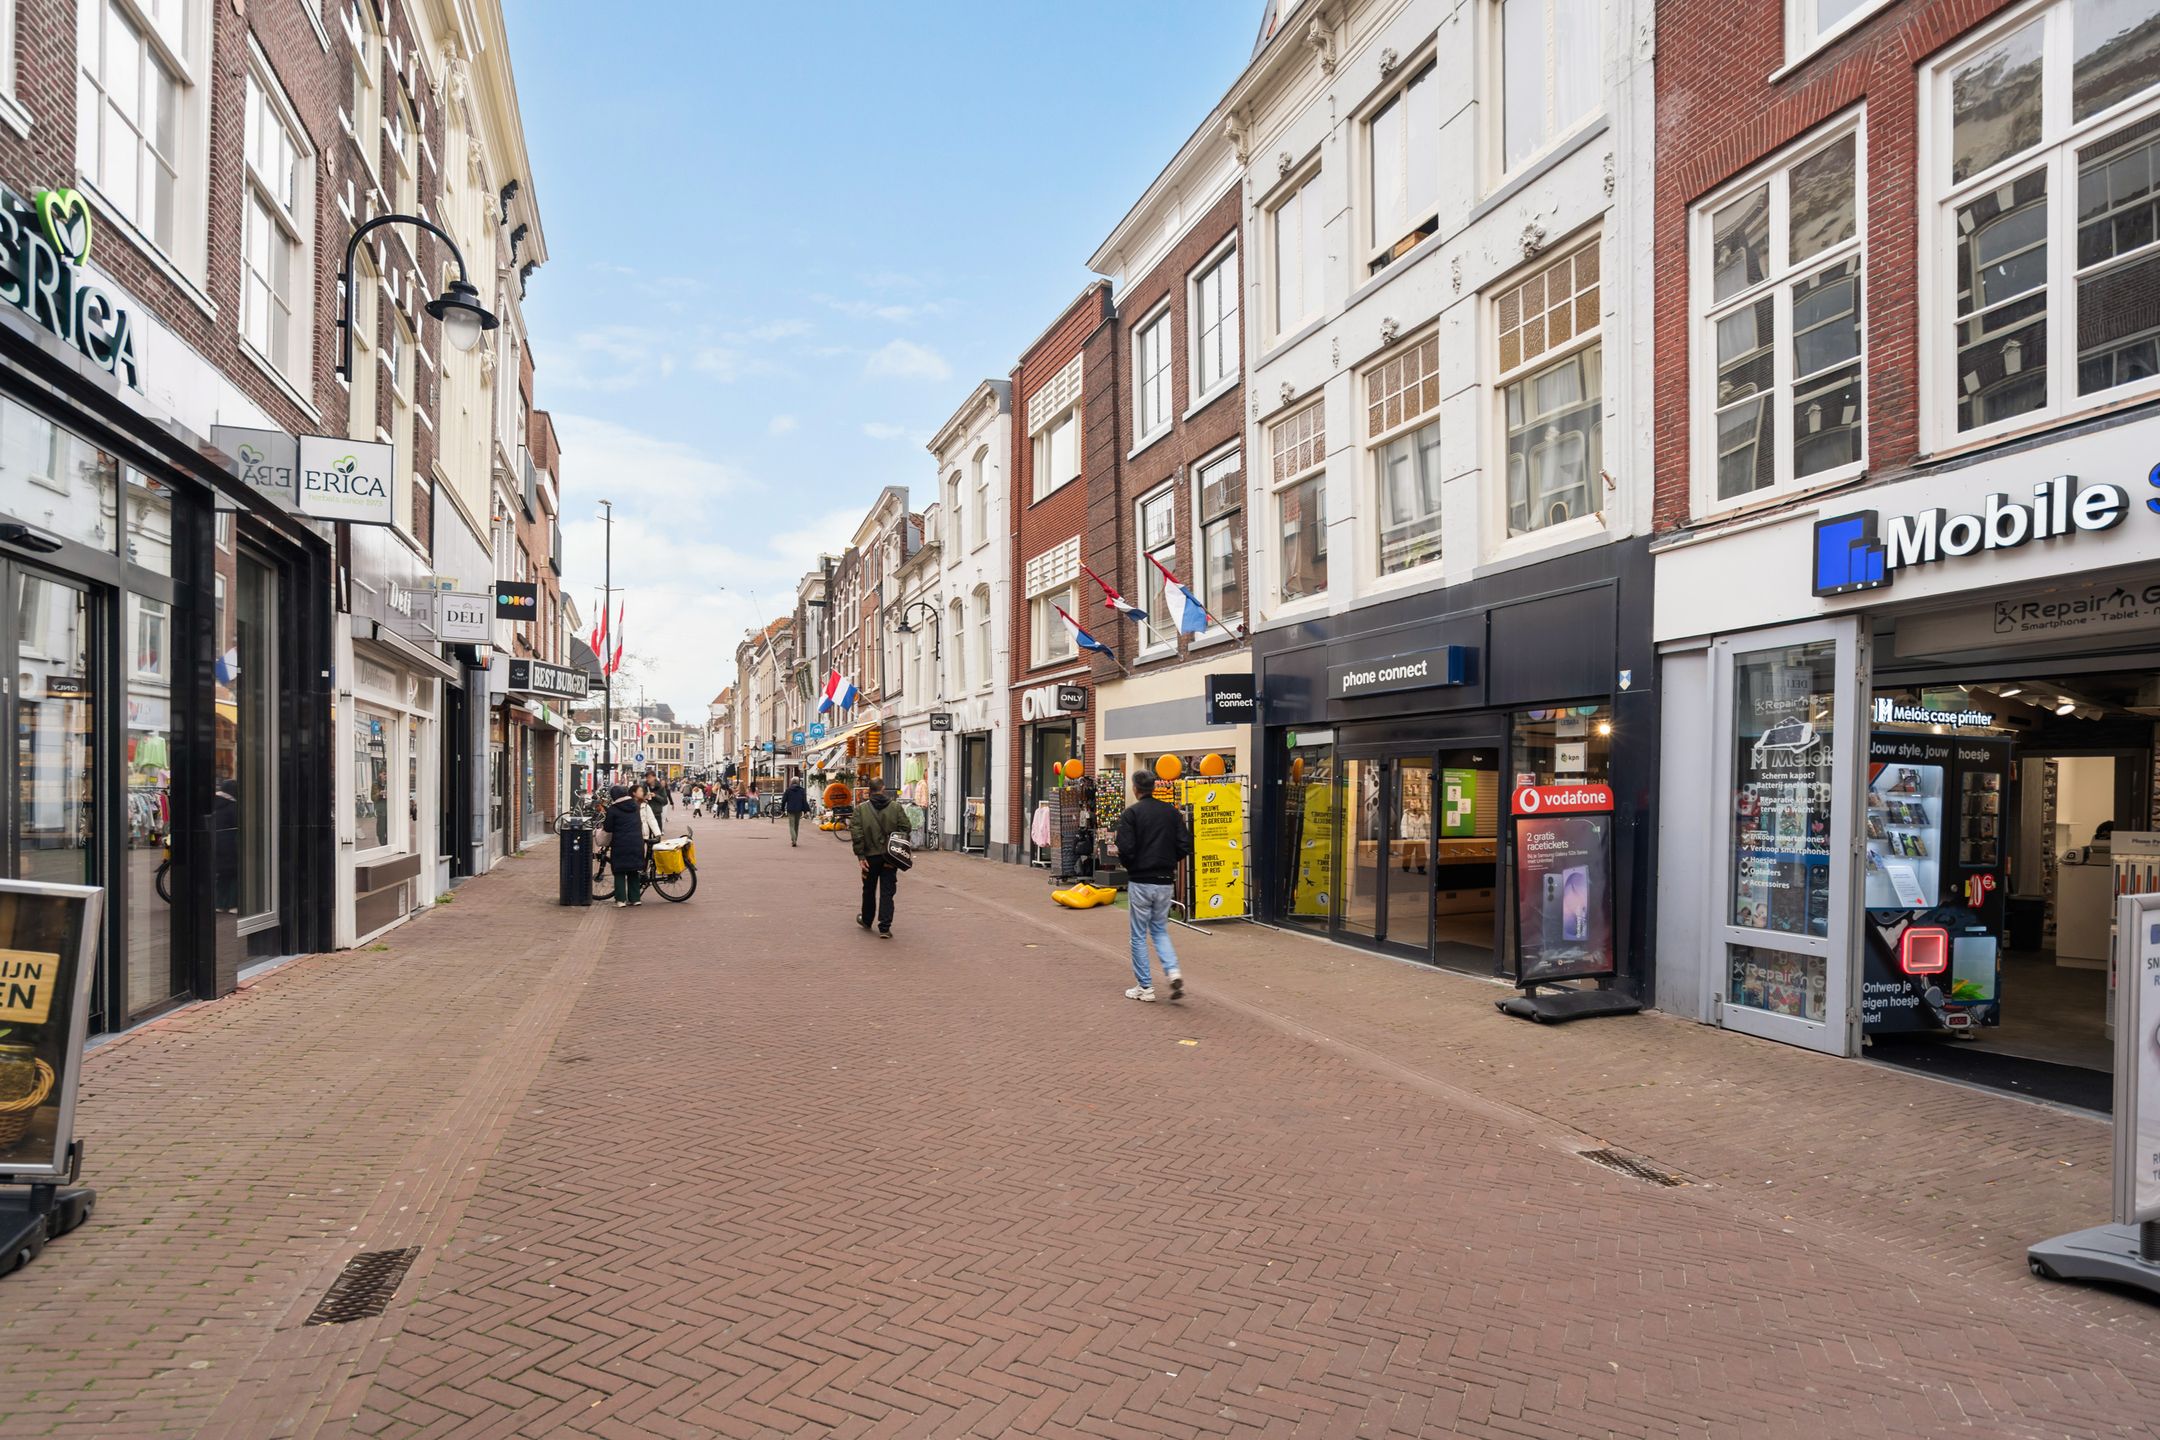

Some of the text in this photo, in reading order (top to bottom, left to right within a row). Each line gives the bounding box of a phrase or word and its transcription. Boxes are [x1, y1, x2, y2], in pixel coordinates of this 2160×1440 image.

[304, 470, 387, 498] ERICA
[1886, 474, 2129, 570] Mobile
[447, 610, 484, 624] DELI
[2020, 616, 2087, 632] Smartphone
[2100, 609, 2139, 621] Tablet
[534, 666, 587, 695] BEST BURGER
[1342, 659, 1428, 692] phone connect
[1022, 680, 1076, 721] ONL
[1060, 694, 1083, 702] ONLY
[1215, 691, 1242, 703] phone
[1219, 698, 1253, 708] connect
[1930, 711, 1957, 723] case
[1957, 709, 1992, 726] printer
[1870, 741, 1990, 762] Jouw style, jouw hoesje
[1568, 754, 1580, 762] kpn
[1761, 771, 1815, 781] Scherm kapot?
[1756, 781, 1784, 790] Batterij
[1544, 789, 1607, 806] vodafone
[1760, 796, 1794, 805] Reparatie
[1200, 804, 1219, 812] NIEUWE
[1200, 810, 1236, 819] SMARTPHONE?
[1207, 816, 1233, 825] GEREGELD
[1526, 831, 1555, 843] 2 gratis
[1750, 834, 1825, 843] Inkoop smartphones
[1527, 840, 1569, 851] racetickets
[1750, 845, 1830, 856] Verkoop smartphones
[890, 846, 910, 859] adidas
[1201, 860, 1225, 868] INTERNET
[1750, 856, 1777, 865] Hoesjes
[1209, 866, 1221, 874] REIS
[1750, 868, 1782, 877] Opladers
[1750, 880, 1790, 889] Accessoires
[1862, 980, 1912, 994] Ontwerp je
[1862, 994, 1920, 1010] eigen hoesje
[1861, 1011, 1882, 1024] hier!
